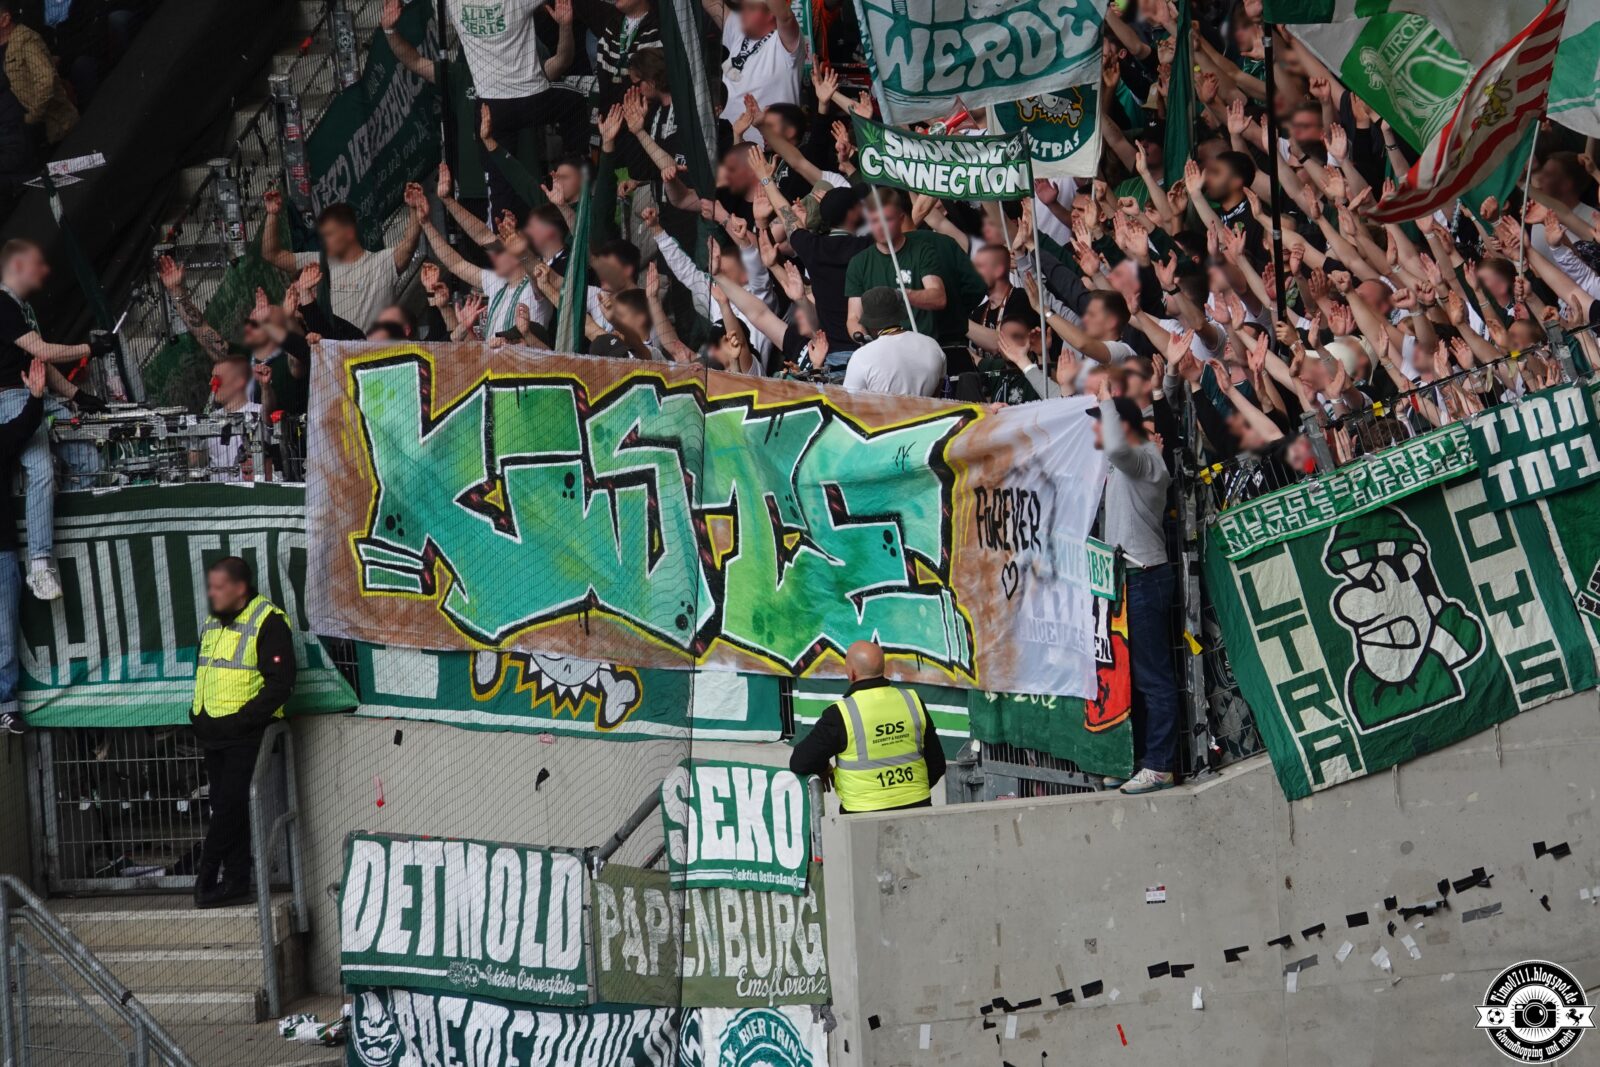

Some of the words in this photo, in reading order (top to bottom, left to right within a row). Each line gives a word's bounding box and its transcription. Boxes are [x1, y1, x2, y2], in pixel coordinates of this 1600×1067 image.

[861, 146, 1030, 196] CONNECTION
[884, 128, 1007, 164] SMOKING
[1471, 387, 1589, 455] תמיד
[1218, 430, 1470, 538] AUSGESPERRTE
[1228, 502, 1337, 554] NIEMALS
[1352, 449, 1475, 507] AUFGEBEN
[1488, 433, 1600, 503] ביחד
[1446, 476, 1572, 712] OYS
[1238, 556, 1367, 786] LTRA
[876, 720, 905, 737] SDS
[662, 766, 805, 870] SEKO
[876, 766, 914, 788] 1236
[341, 839, 585, 969] DETMOLD
[595, 881, 827, 977] PAPENBURG
[739, 1018, 767, 1047] BIER
